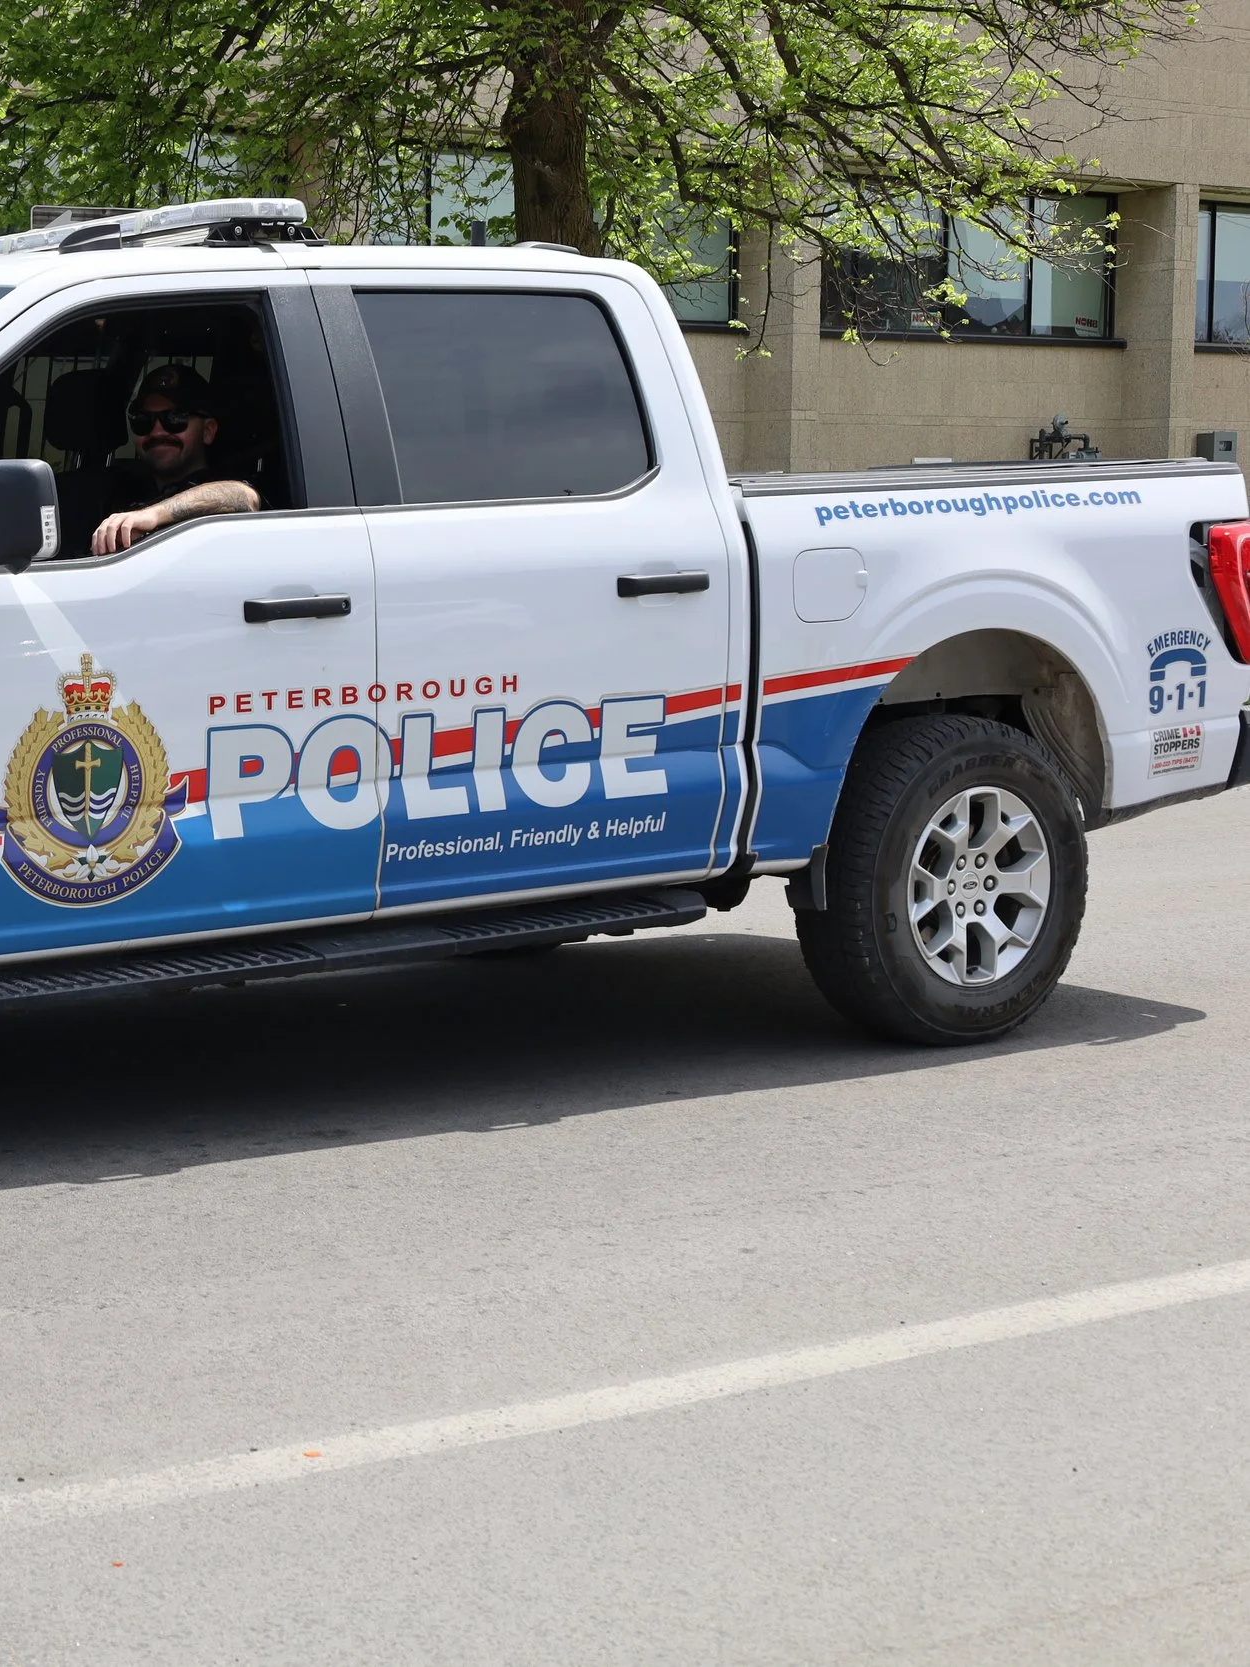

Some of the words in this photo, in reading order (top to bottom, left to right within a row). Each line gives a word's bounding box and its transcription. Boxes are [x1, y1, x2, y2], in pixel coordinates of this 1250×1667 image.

[814, 488, 1143, 526] peterboroughpolice.com
[1147, 630, 1211, 658] EMERGENCY
[208, 674, 518, 715] PETERBOROUGH
[51, 725, 123, 752] PROFESSIONAL
[1153, 728, 1182, 743] CRIME
[1153, 737, 1201, 756] STOPPERS
[205, 693, 670, 841] POLICE
[32, 768, 54, 830] FRIENDLY
[120, 763, 140, 820] HELPFUL
[385, 831, 505, 863] Professional,
[510, 823, 583, 847] Friendly
[587, 820, 601, 840] &
[605, 811, 667, 839] Helpful
[17, 862, 118, 900] PETERBOROUGH
[122, 847, 165, 887] POLICE
